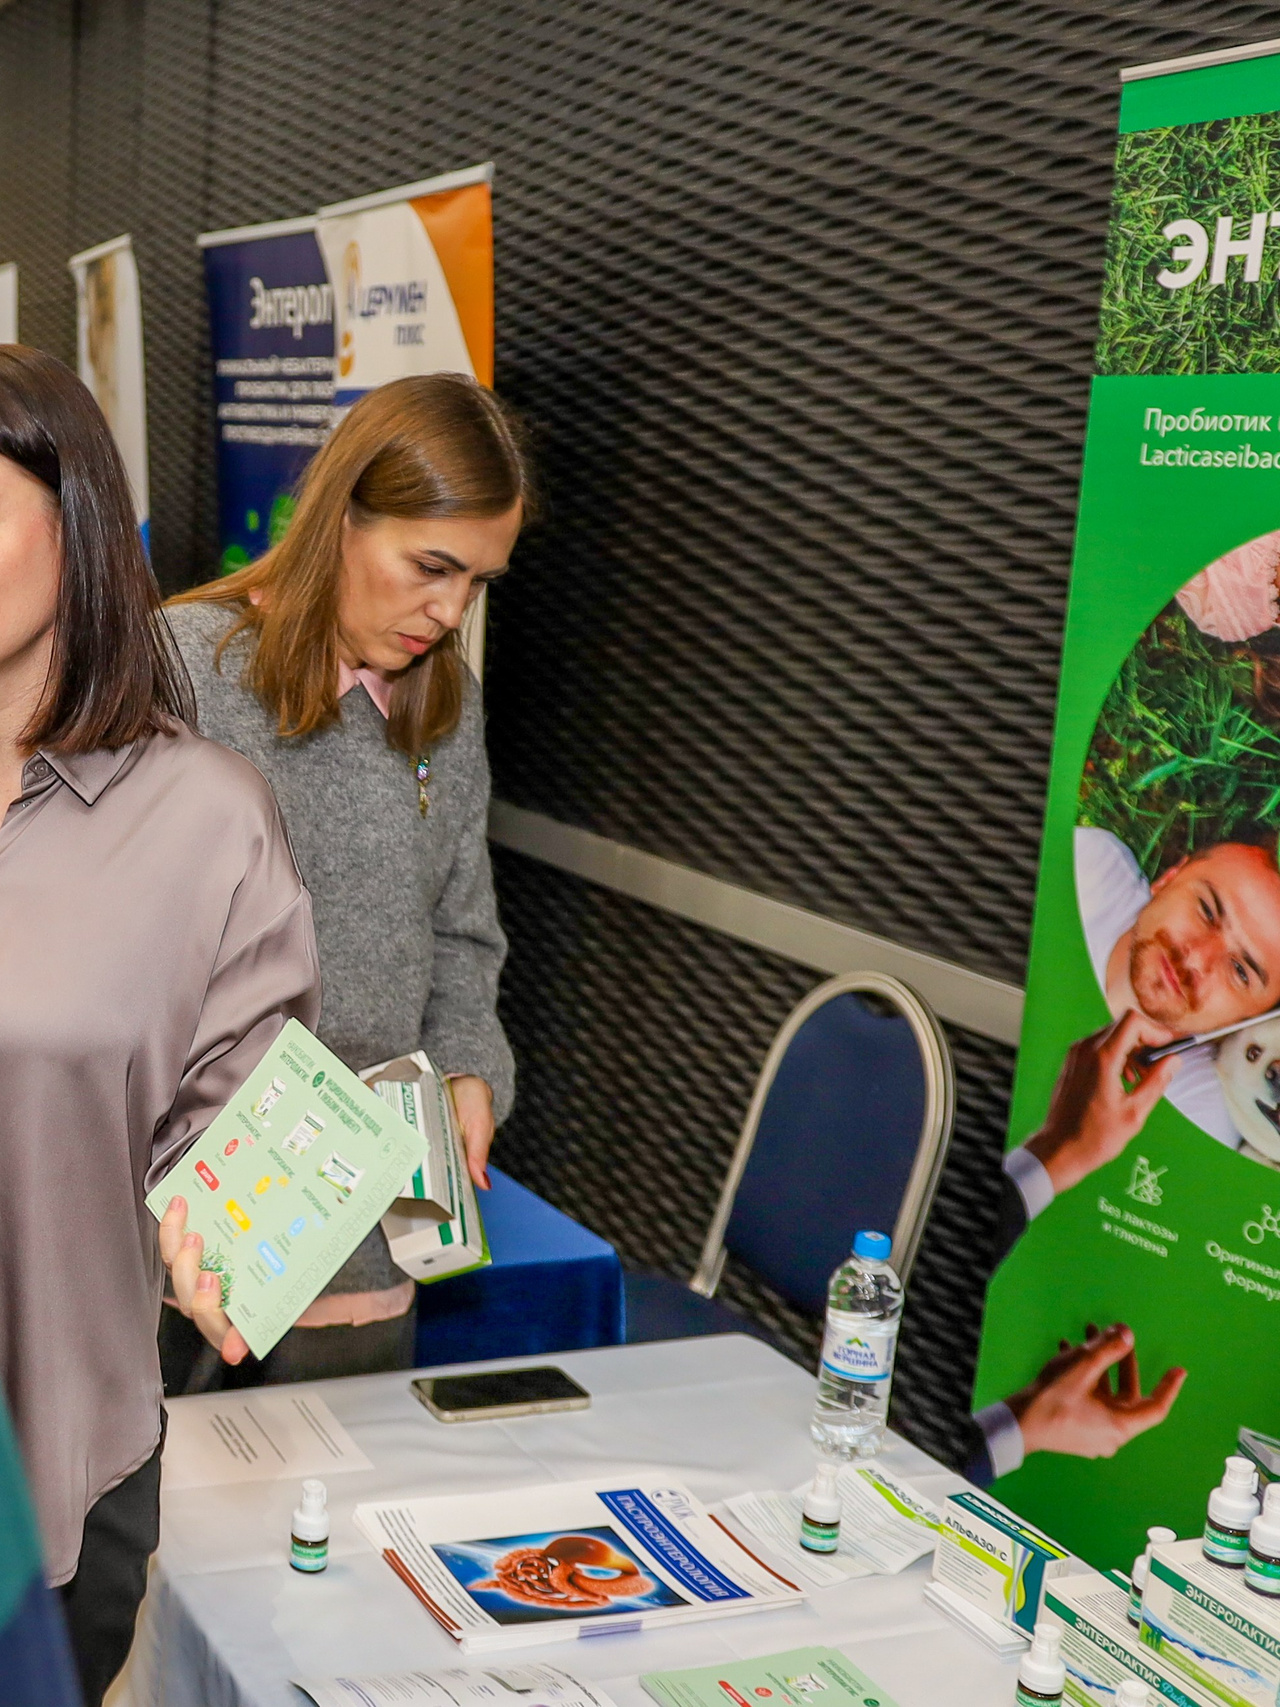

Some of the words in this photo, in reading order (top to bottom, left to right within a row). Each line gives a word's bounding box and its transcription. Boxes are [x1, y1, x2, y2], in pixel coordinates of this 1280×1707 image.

[1156, 211, 1280, 290] ЭН
[1144, 407, 1272, 438] Пробиотик
[1112, 1225, 1168, 1258] глютена
[1122, 1210, 1178, 1242] лактозы
[616, 1495, 730, 1597] ГАСТРОЭНТЕРОЛОГИЯ
[1074, 1617, 1161, 1688] ЭНТЕРОЛАКТИС
